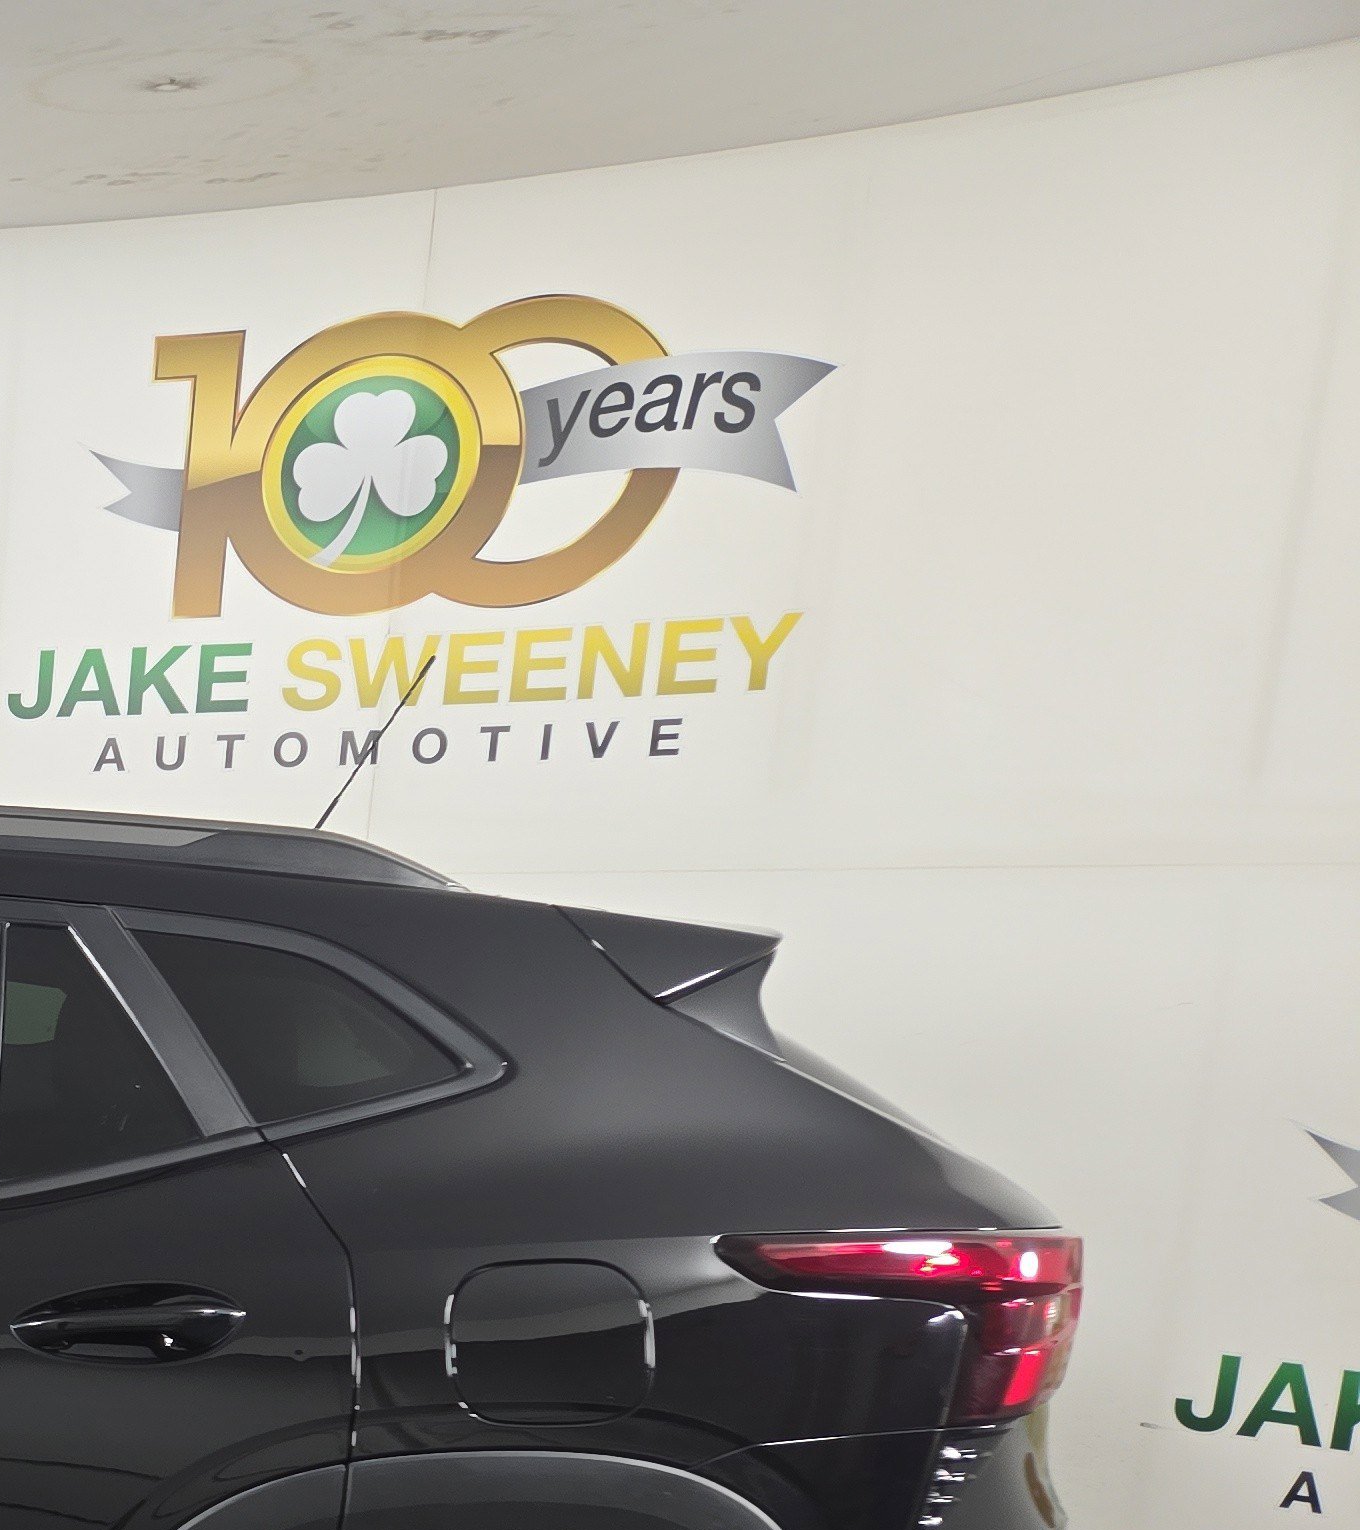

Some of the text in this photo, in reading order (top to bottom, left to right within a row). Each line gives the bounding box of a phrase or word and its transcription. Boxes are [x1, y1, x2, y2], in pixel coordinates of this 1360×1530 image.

[154, 294, 760, 620] 100 years
[7, 612, 804, 720] JAKE SWEENEY
[94, 717, 683, 773] AUTOMOTIVE
